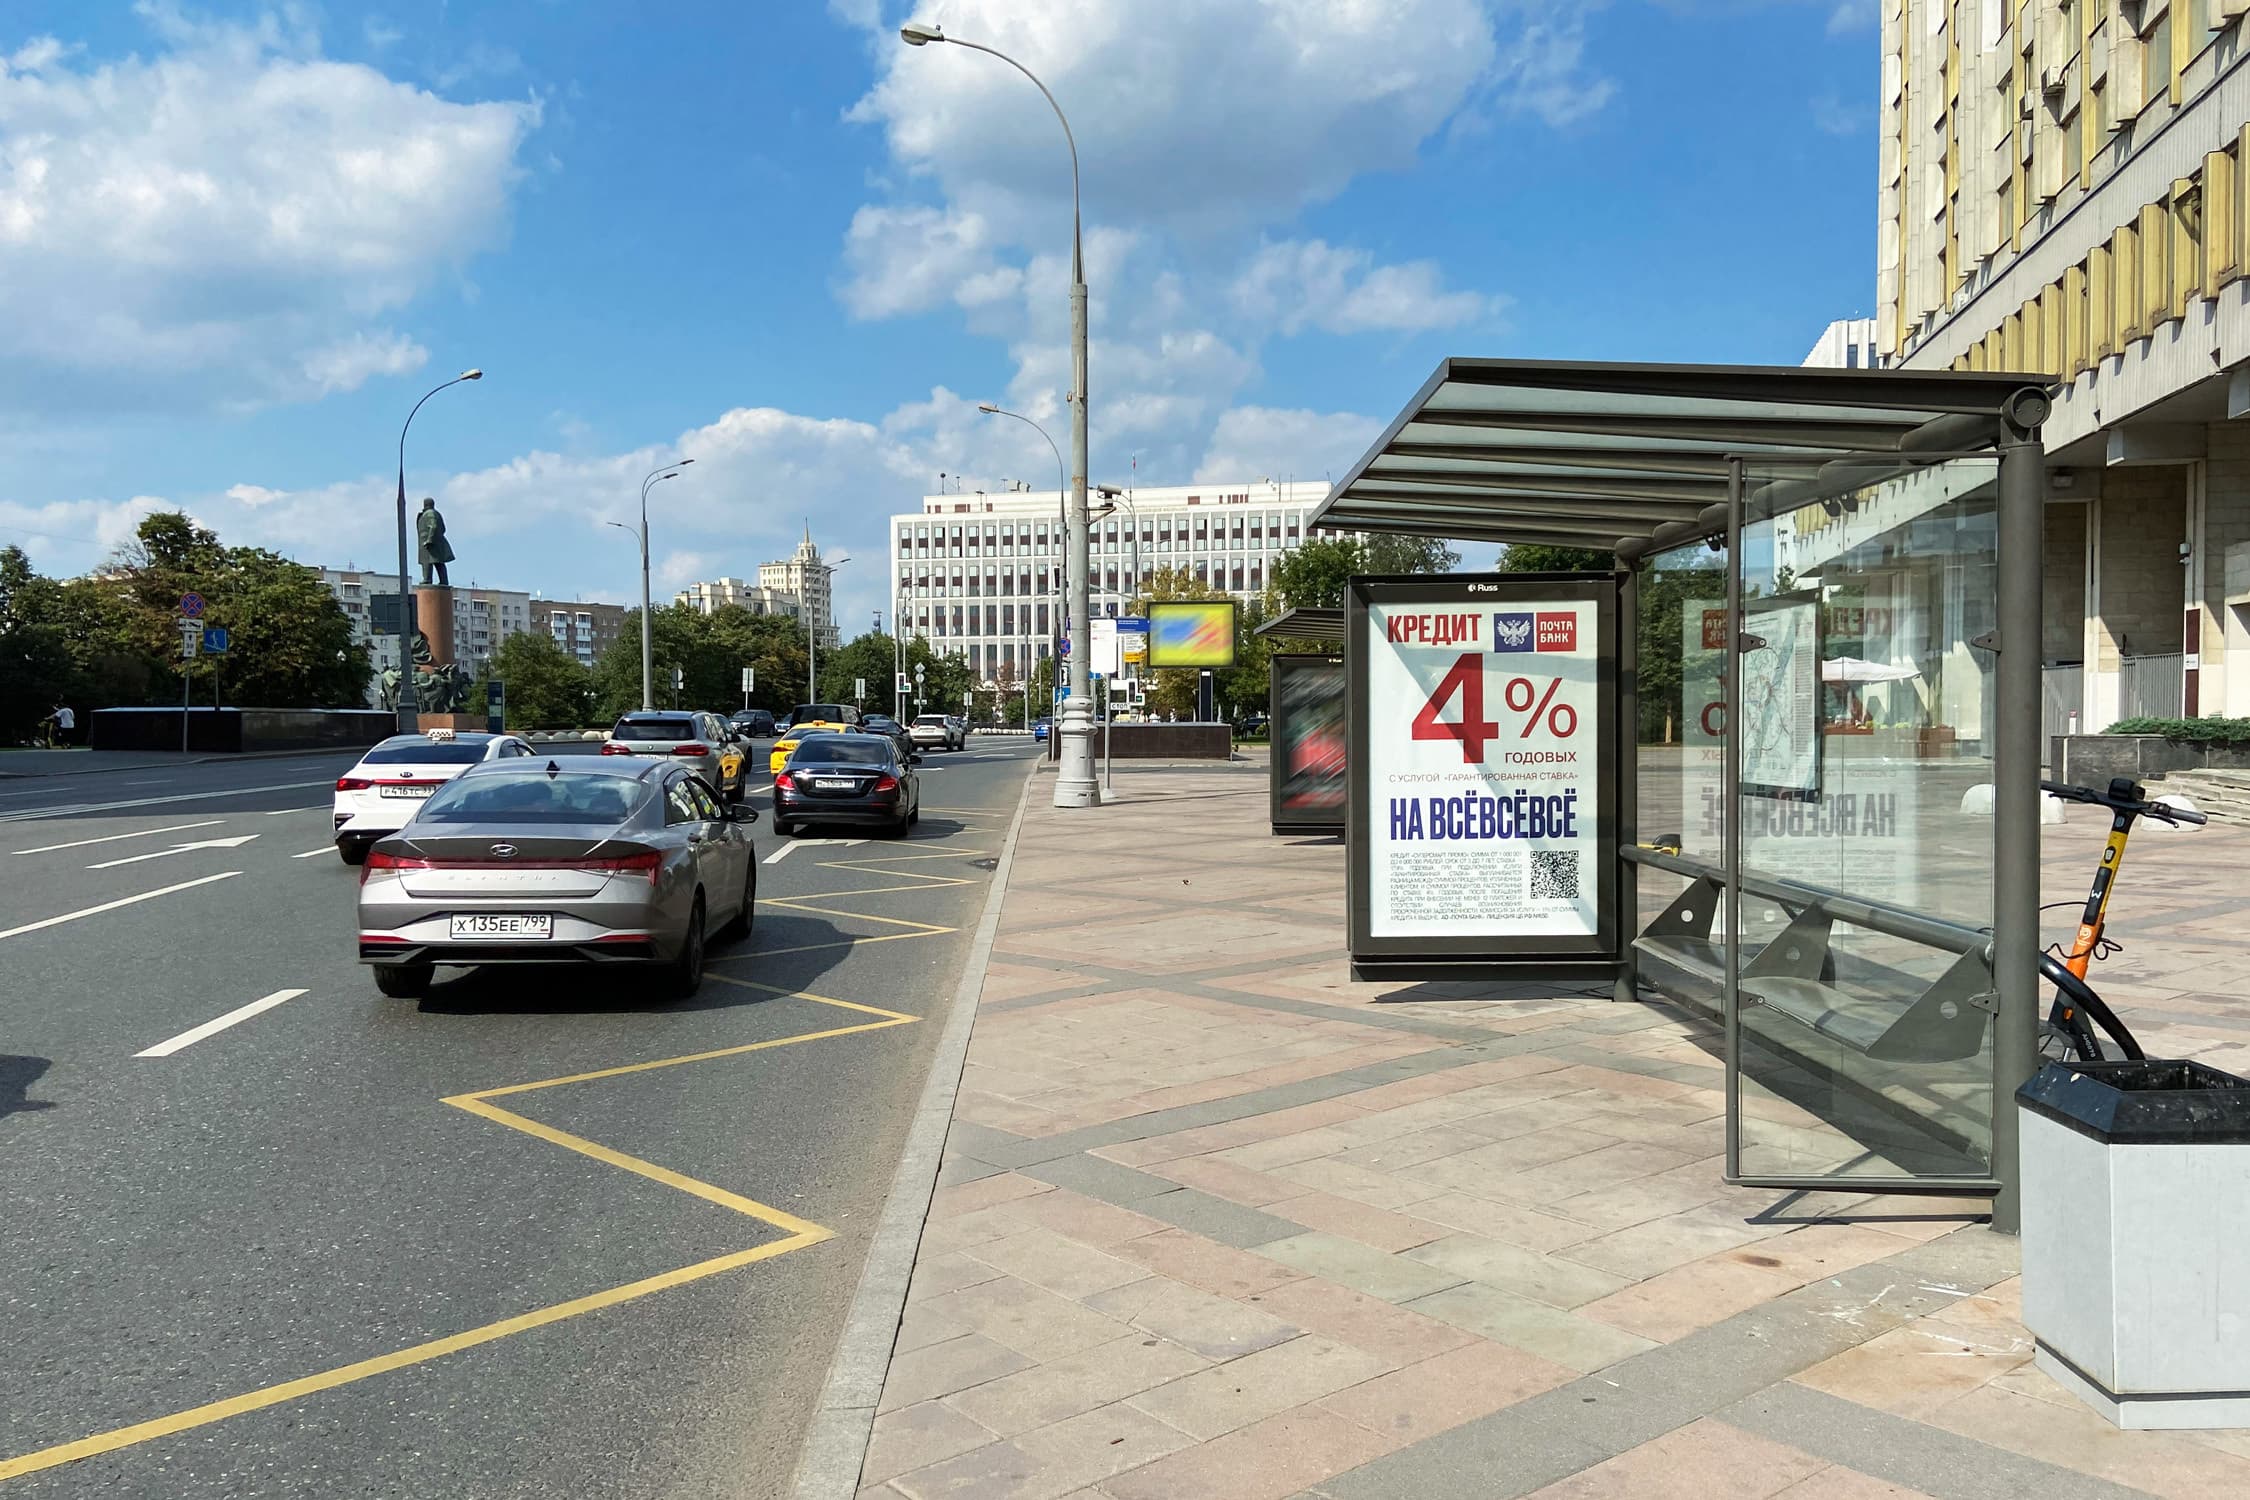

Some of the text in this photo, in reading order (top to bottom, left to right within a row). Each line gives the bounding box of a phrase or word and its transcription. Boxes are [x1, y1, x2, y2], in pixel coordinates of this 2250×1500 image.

[1477, 584, 1498, 592] Russ
[1387, 614, 1482, 646] КРЕДИТ
[1540, 621, 1573, 631] ПОЧТА
[1540, 633, 1569, 643] БАНК
[1505, 751, 1577, 765] ГОДОВЫХ
[1389, 771, 1579, 783] С УСЛУГОЙ «ГАРАНТИРОВАННАЯ СТАВКА»
[1390, 788, 1578, 840] НА ВСЁВСЁВСЁ
[522, 916, 547, 928] 799
